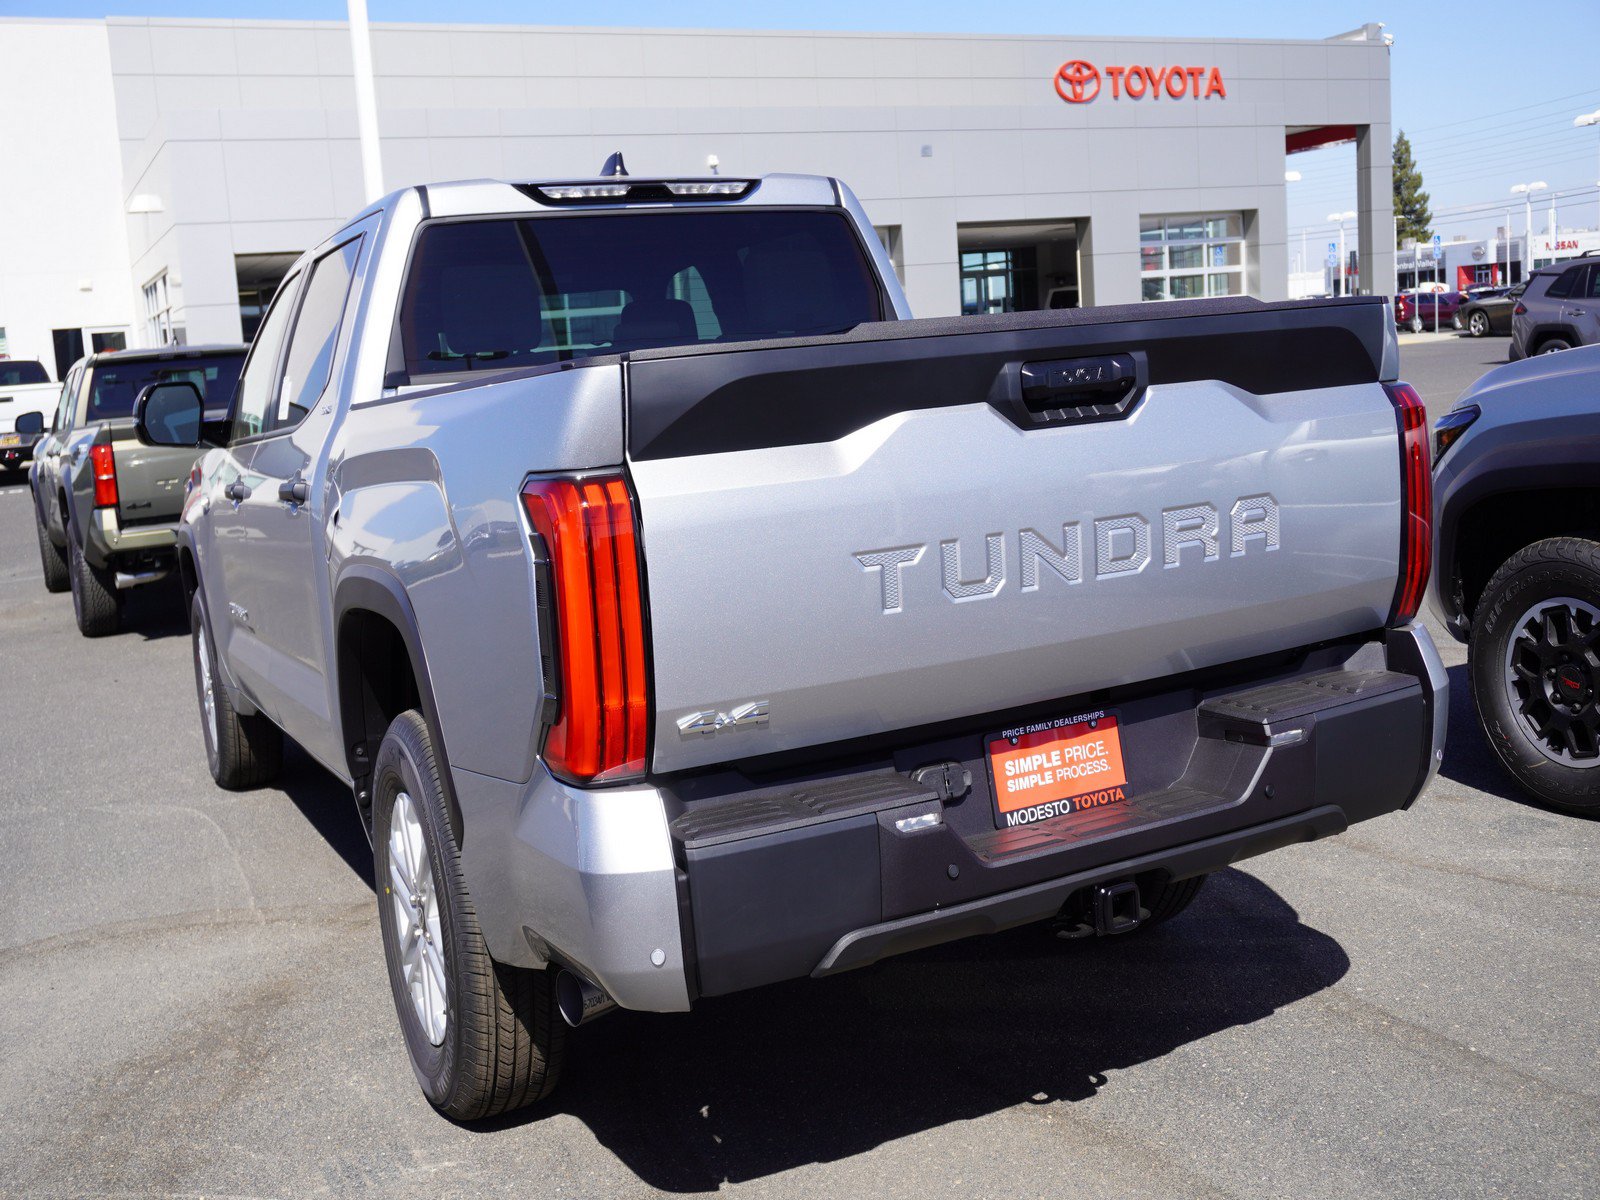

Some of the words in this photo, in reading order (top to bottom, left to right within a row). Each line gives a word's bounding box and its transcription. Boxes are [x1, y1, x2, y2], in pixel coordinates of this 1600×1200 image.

[1105, 65, 1227, 99] TOYOTA
[1545, 240, 1578, 250] NSSAN
[1395, 260, 1415, 270] entral
[852, 492, 1280, 615] TUNDRA
[1002, 727, 1025, 738] PRICE
[1026, 721, 1052, 734] FAMILY
[1054, 710, 1105, 728] DEALERSHIPS
[1004, 750, 1062, 776] SIMPLE
[1064, 740, 1109, 763] PRICE.
[1007, 771, 1053, 792] SIMPLE
[1056, 759, 1111, 782] PROCESS.
[1006, 799, 1070, 827] MODESTO
[1072, 787, 1126, 811] TOYOTA
